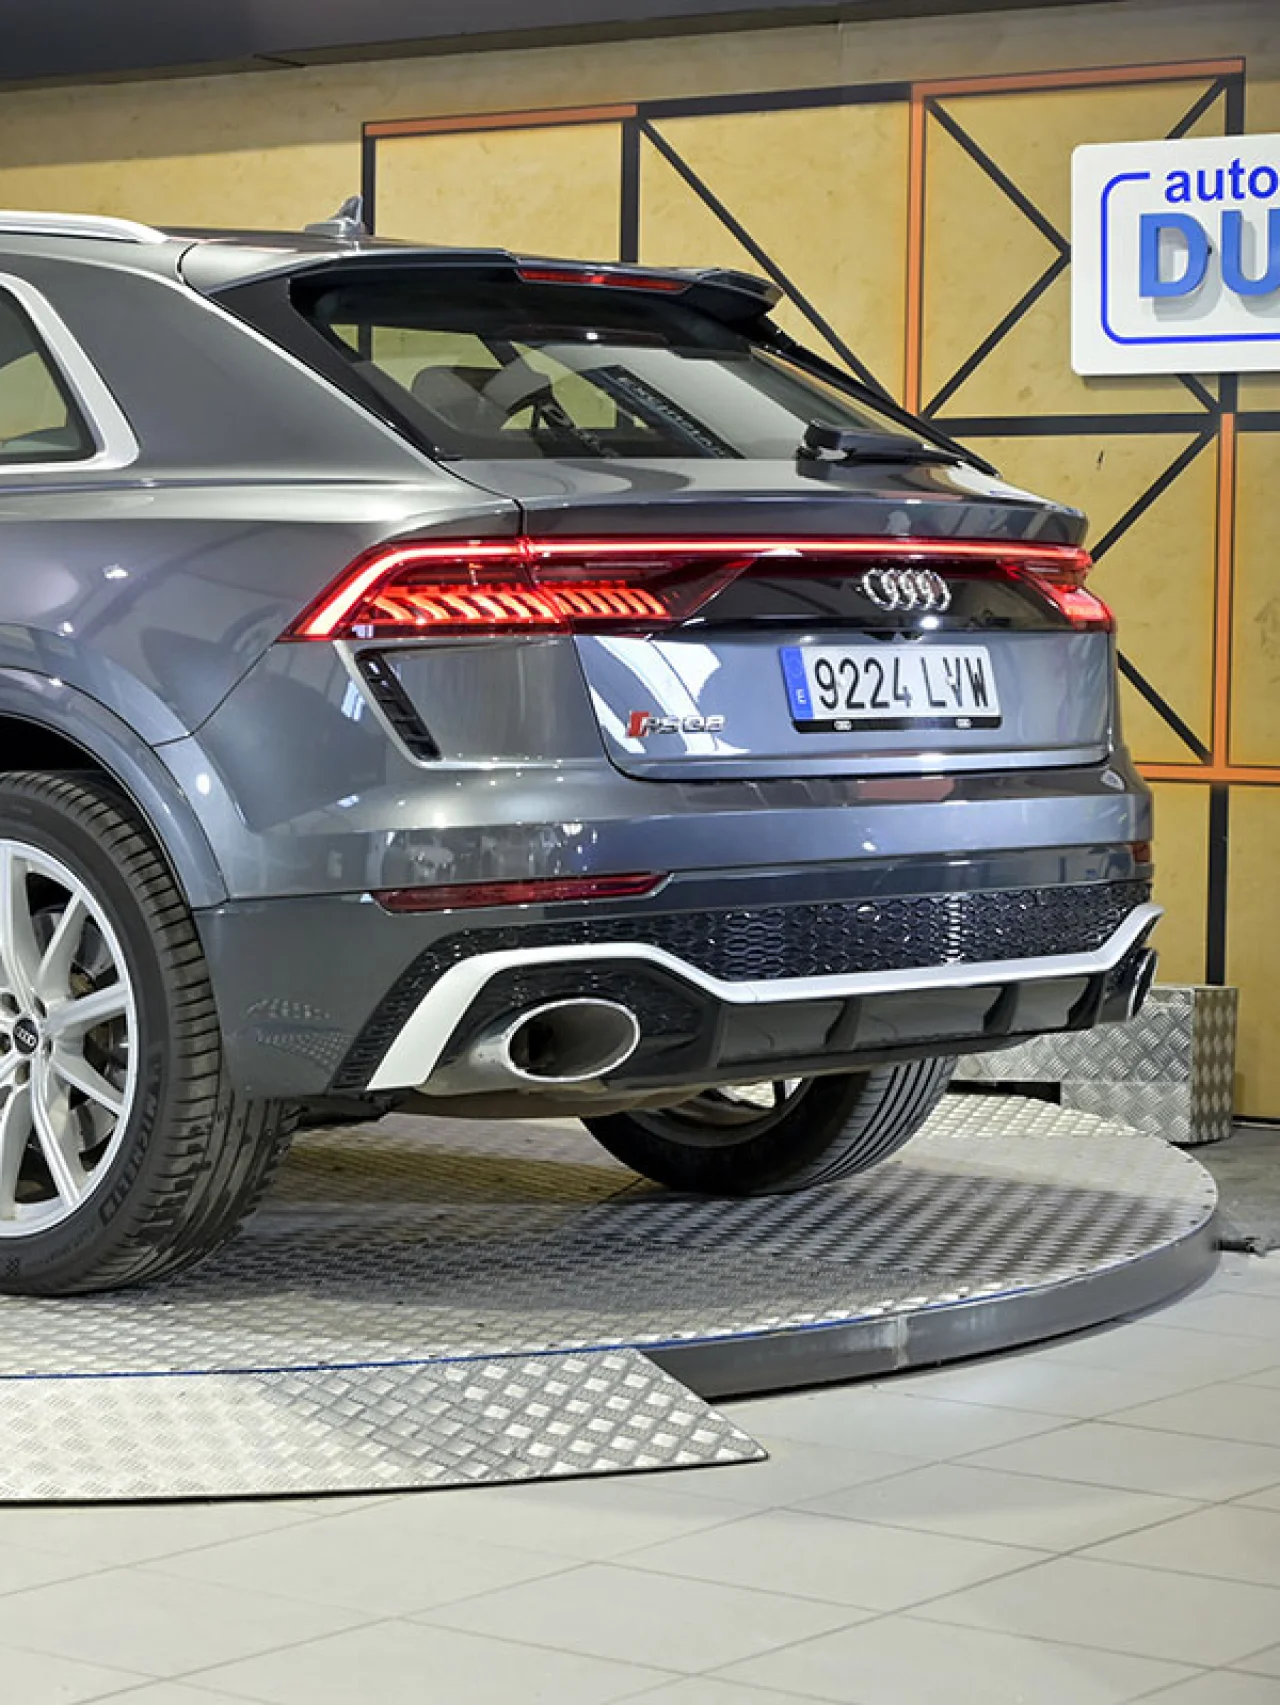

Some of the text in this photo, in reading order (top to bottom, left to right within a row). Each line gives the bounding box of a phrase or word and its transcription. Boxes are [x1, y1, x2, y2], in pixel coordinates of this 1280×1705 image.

[1139, 208, 1280, 298] DU
[814, 656, 989, 710] 9224 LVW
